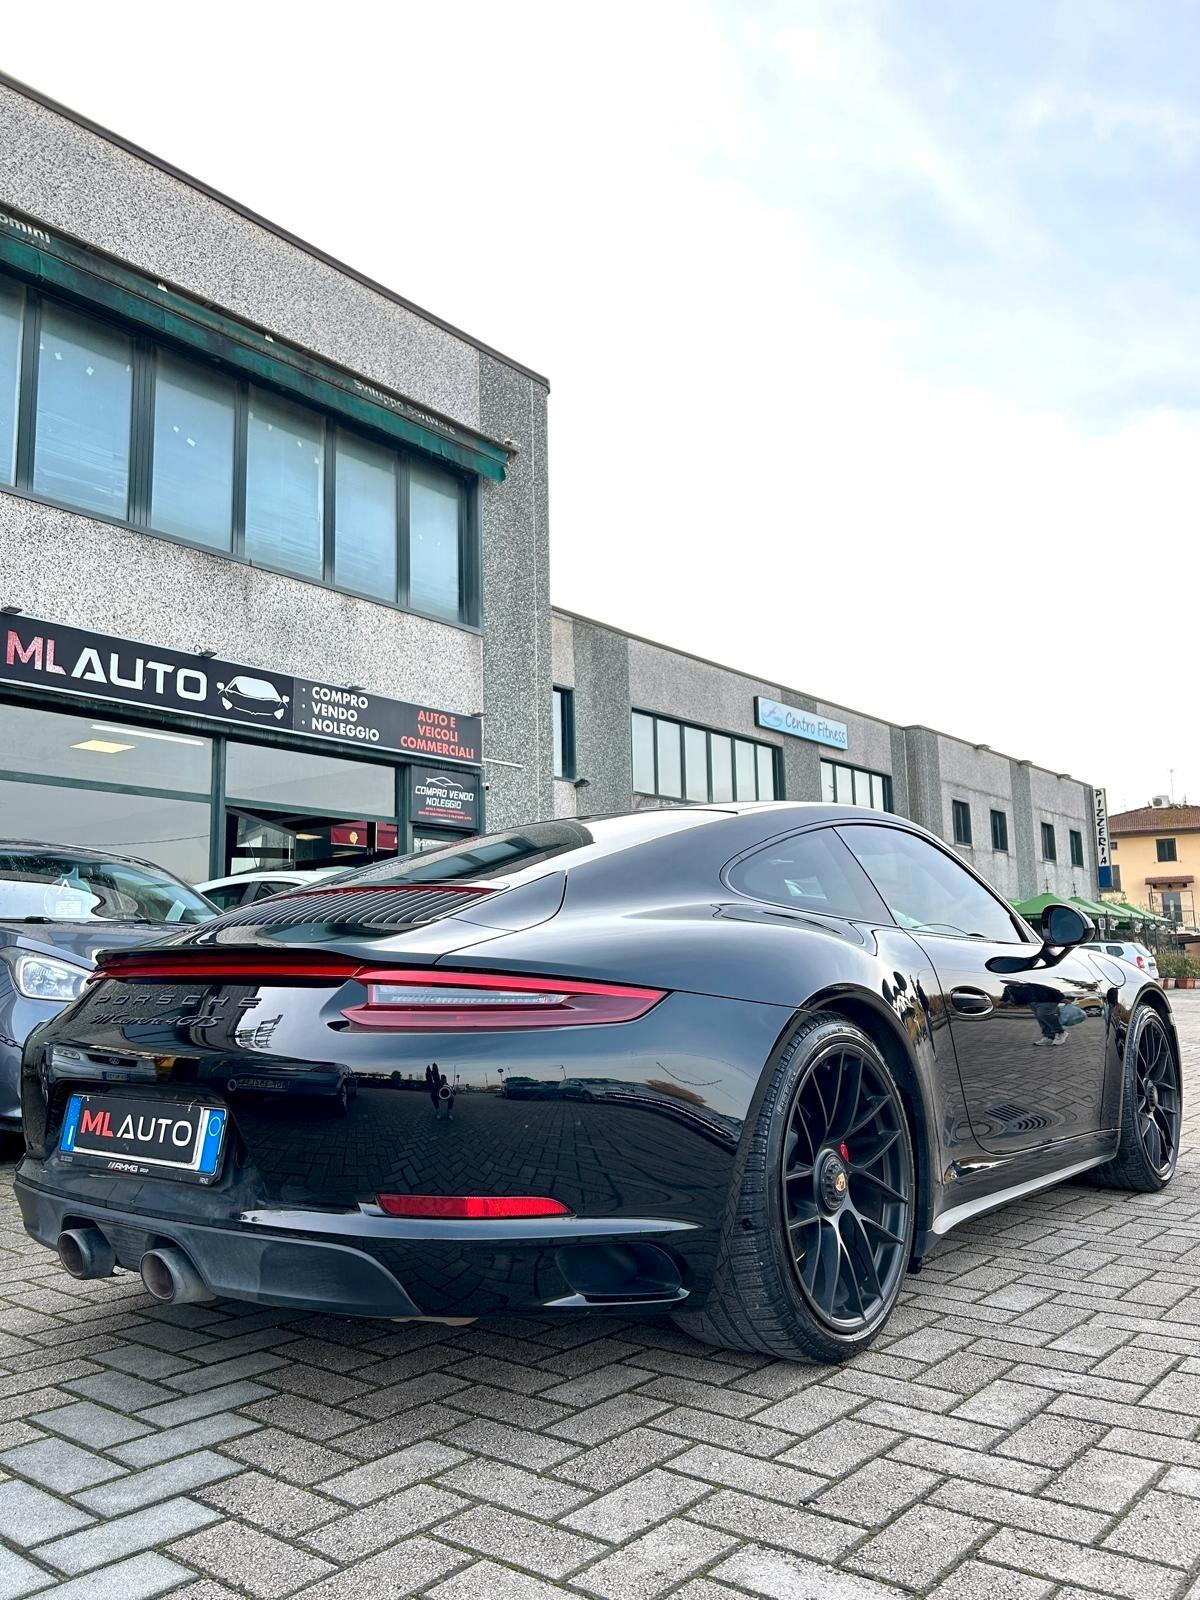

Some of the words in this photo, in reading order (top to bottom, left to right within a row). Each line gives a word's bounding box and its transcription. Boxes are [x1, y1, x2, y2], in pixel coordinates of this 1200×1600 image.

[70, 647, 208, 701] AUTO
[311, 686, 369, 709] COMPRO
[311, 701, 358, 722] VENDO
[417, 710, 448, 726] AUTO
[450, 716, 456, 728] E
[311, 717, 380, 741] NOLEGGIO
[417, 724, 458, 743] VEICOLI
[785, 711, 816, 734] Centro
[817, 721, 846, 744] Fitness
[400, 735, 474, 759] COMMERCIALI
[415, 785, 447, 798] COMPRO
[449, 790, 474, 801] VENDO
[425, 797, 462, 809] NOLEGGIO
[1095, 789, 1107, 865] PIZZERIA
[94, 994, 262, 1009] PORSCHE
[116, 1114, 193, 1147] AUTO
